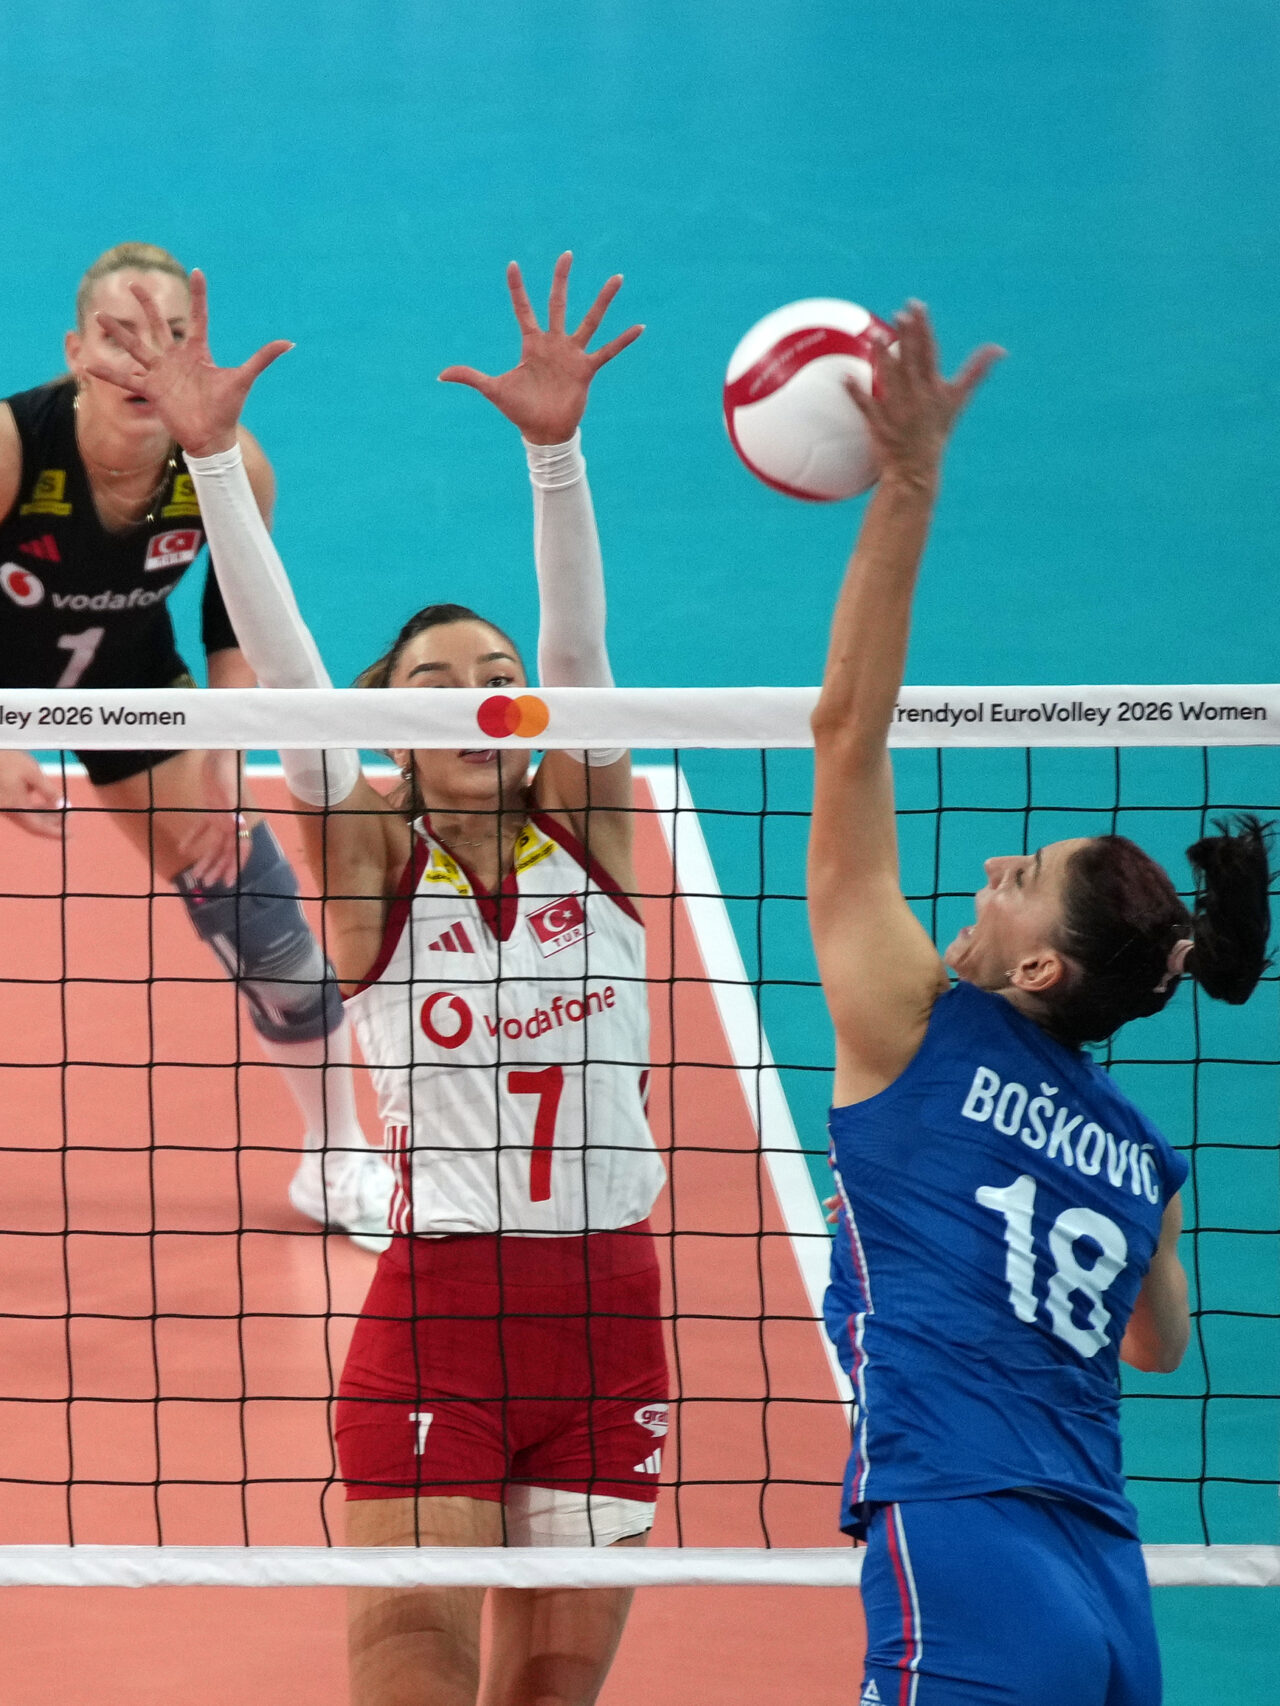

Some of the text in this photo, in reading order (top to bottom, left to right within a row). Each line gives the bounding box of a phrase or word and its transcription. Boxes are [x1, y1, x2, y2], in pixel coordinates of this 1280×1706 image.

[37, 706, 93, 726] 2026
[99, 706, 186, 726] Women
[894, 701, 1267, 728] rendyol EuroVolley 2026 Women
[552, 928, 582, 947] TUR
[483, 985, 616, 1040] vodafone
[507, 1065, 564, 1203] 7
[974, 1173, 1129, 1359] 18
[408, 1411, 434, 1456] 7
